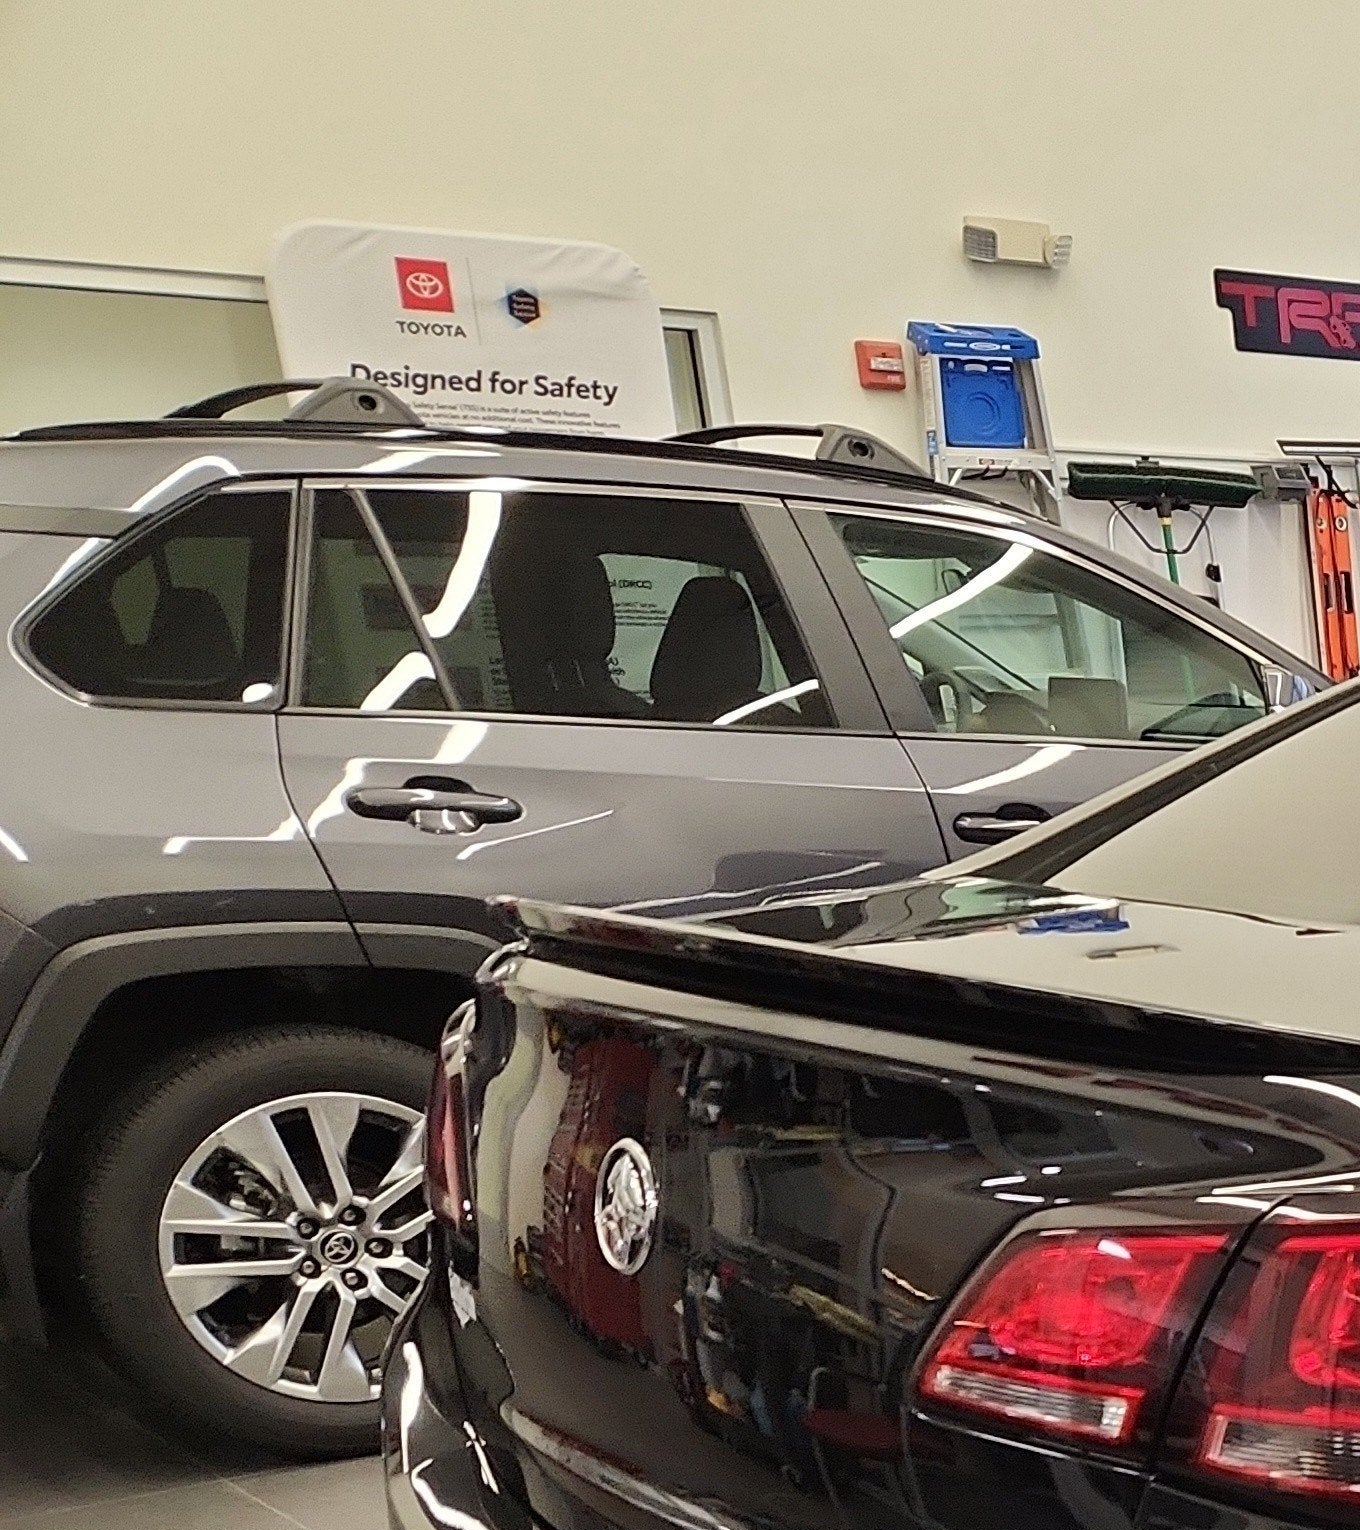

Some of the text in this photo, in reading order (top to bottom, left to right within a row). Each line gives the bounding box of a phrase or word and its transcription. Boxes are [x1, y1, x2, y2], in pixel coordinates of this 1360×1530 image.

[396, 320, 467, 339] TOYOTA
[350, 363, 619, 406] Designed for Safety
